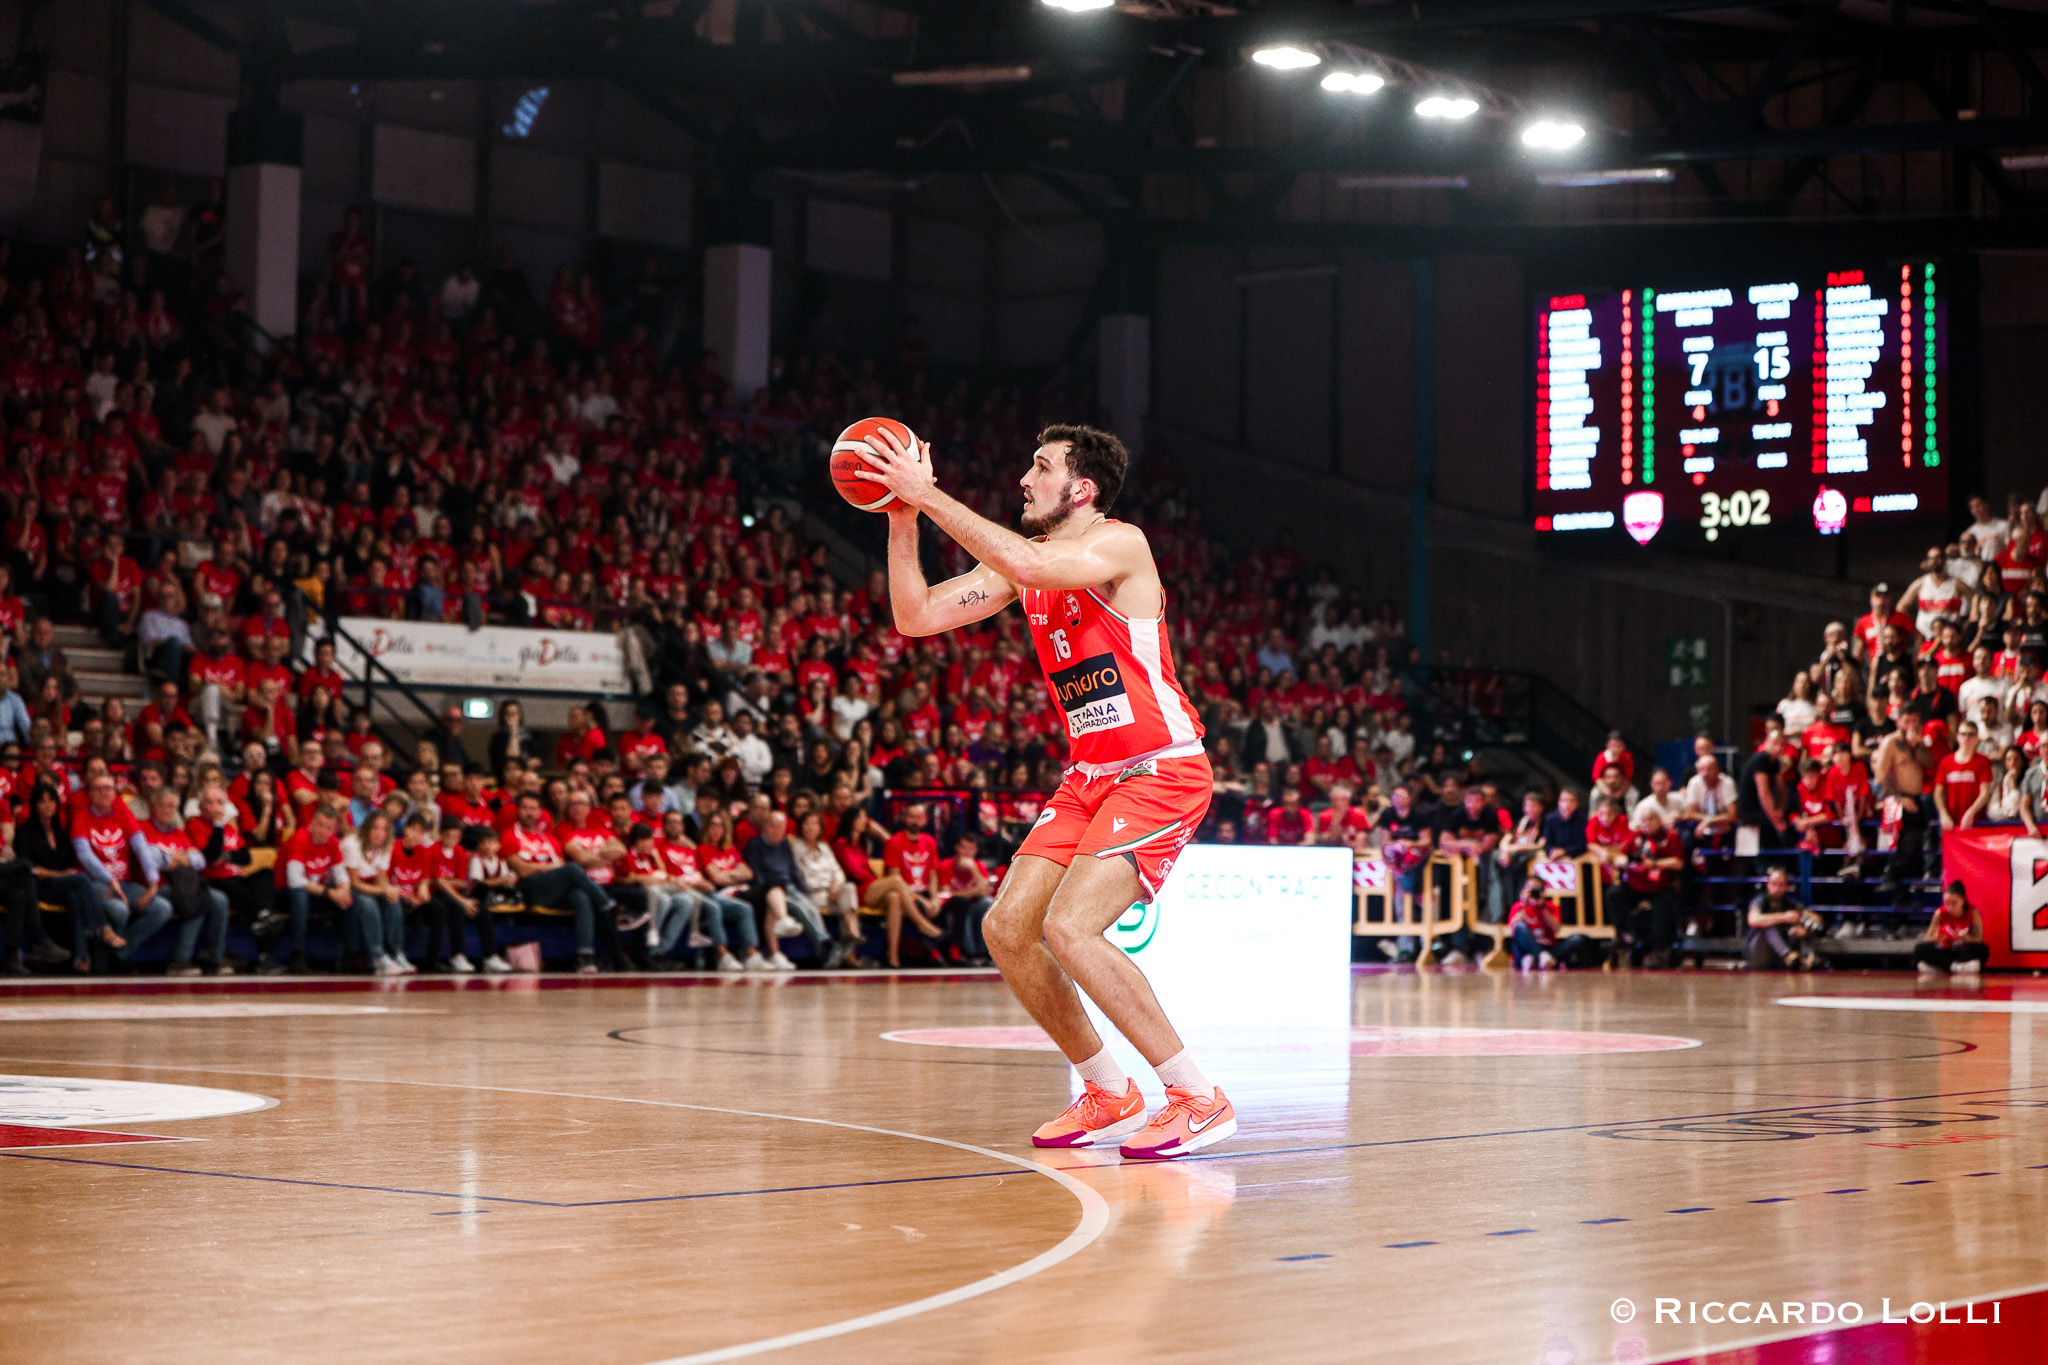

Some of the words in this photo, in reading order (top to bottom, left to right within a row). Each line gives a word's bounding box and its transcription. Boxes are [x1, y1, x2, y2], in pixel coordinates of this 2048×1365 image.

[1687, 353, 1709, 387] 7
[1753, 345, 1791, 380] 15
[1700, 489, 1771, 528] 3:02
[1049, 628, 1072, 663] 16
